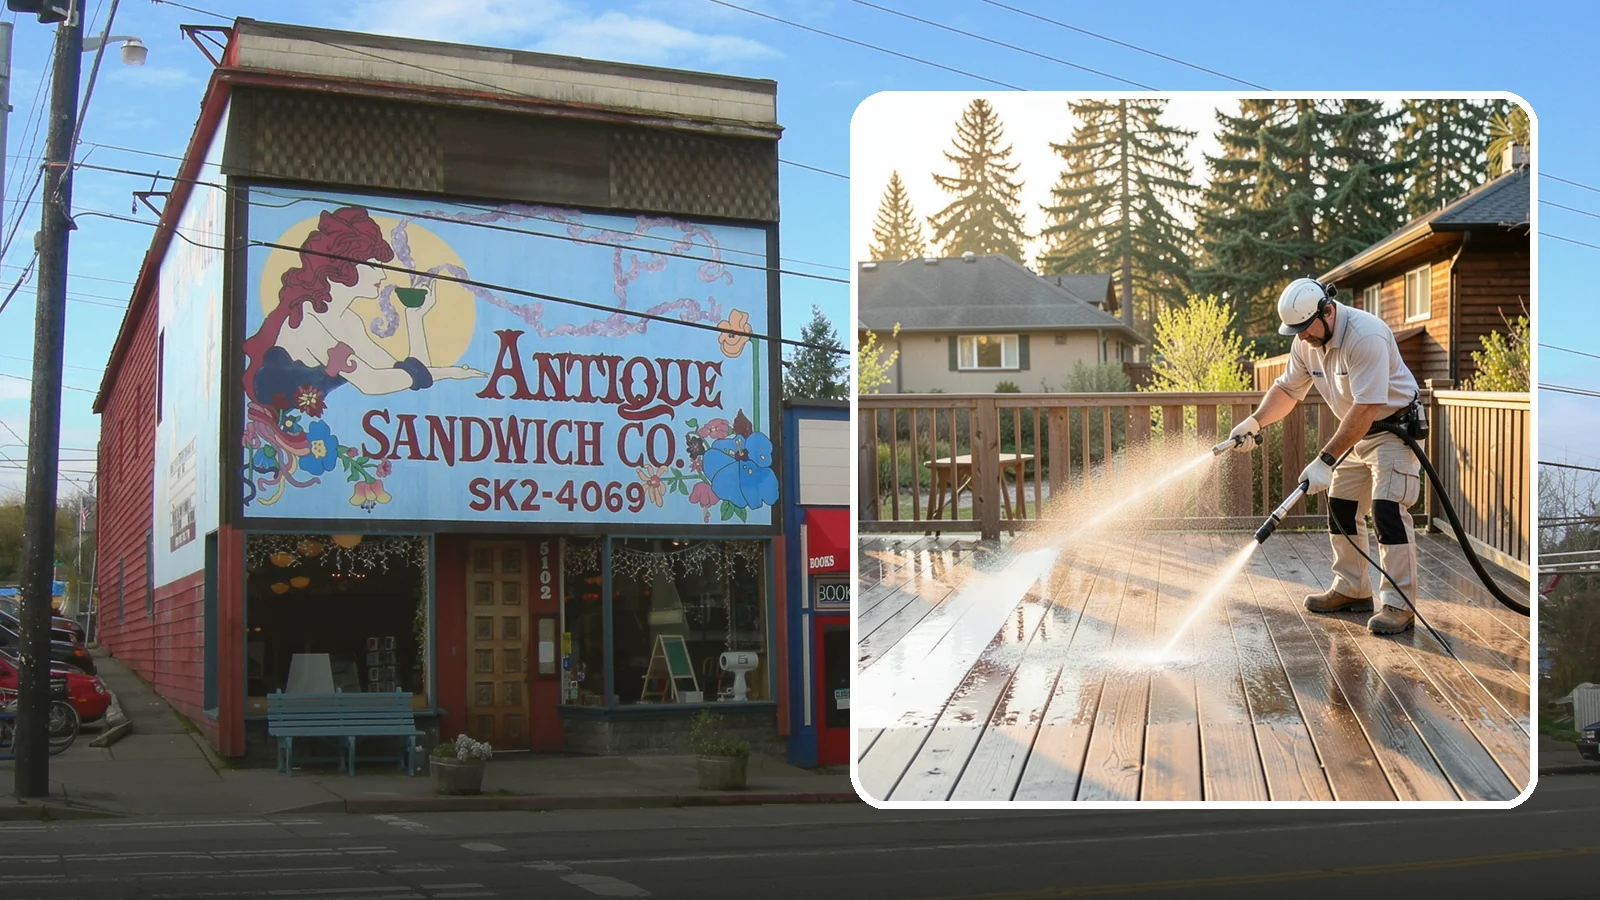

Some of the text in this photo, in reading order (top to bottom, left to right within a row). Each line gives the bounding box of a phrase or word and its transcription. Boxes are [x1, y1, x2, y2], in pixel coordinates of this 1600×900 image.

[476, 329, 723, 420] ANTIQUE
[361, 408, 684, 469] SANDWICH CO.
[469, 479, 645, 512] SK2-4069
[539, 541, 551, 600] 5102
[809, 555, 835, 568] BOOKS
